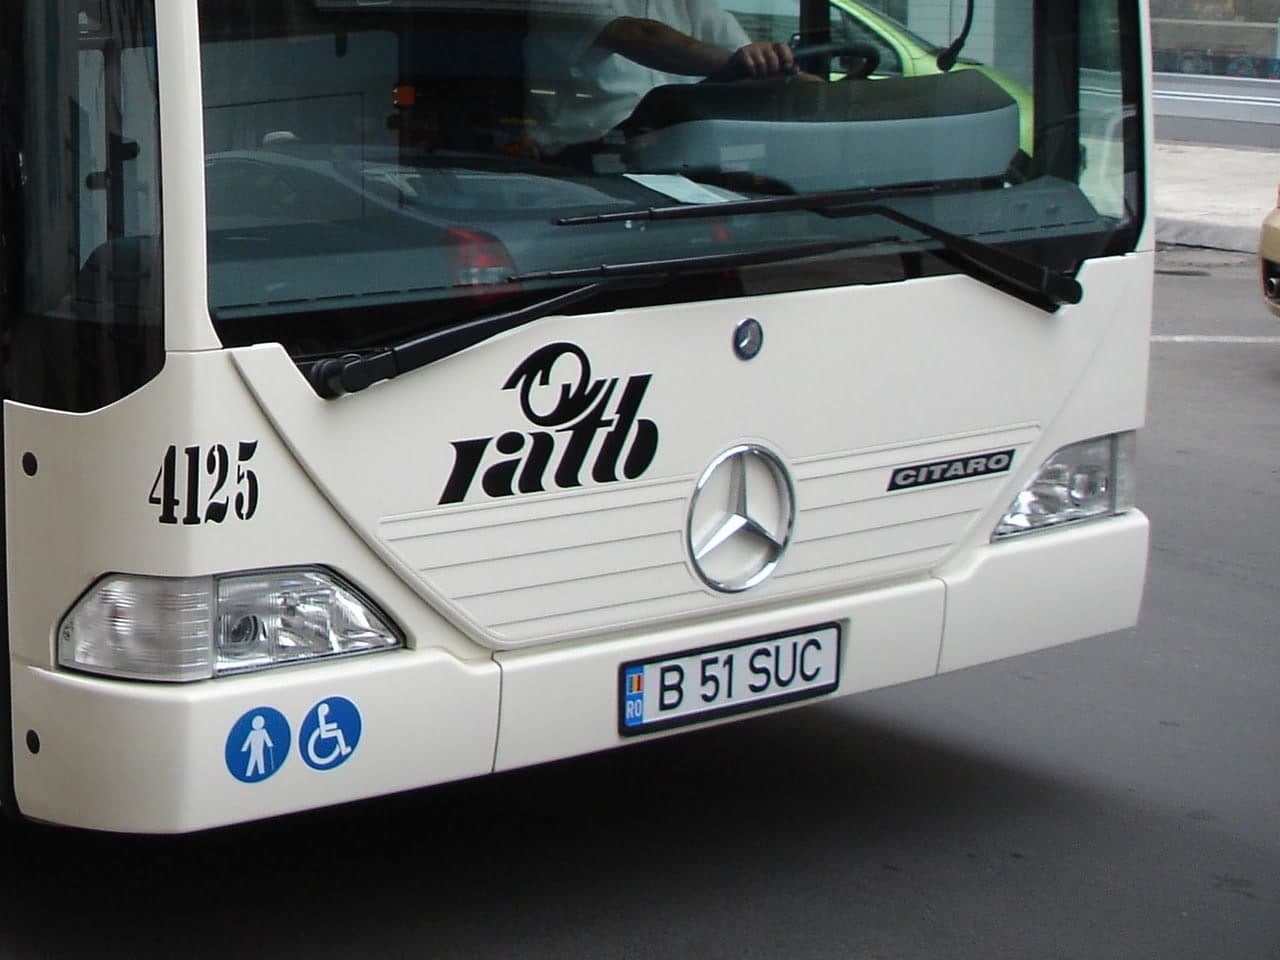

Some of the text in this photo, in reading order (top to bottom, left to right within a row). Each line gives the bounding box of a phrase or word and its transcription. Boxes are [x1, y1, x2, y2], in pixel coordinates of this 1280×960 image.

[148, 440, 259, 525] 4125
[893, 453, 1011, 486] CITARO
[626, 638, 822, 720] RO B 51 SUC
